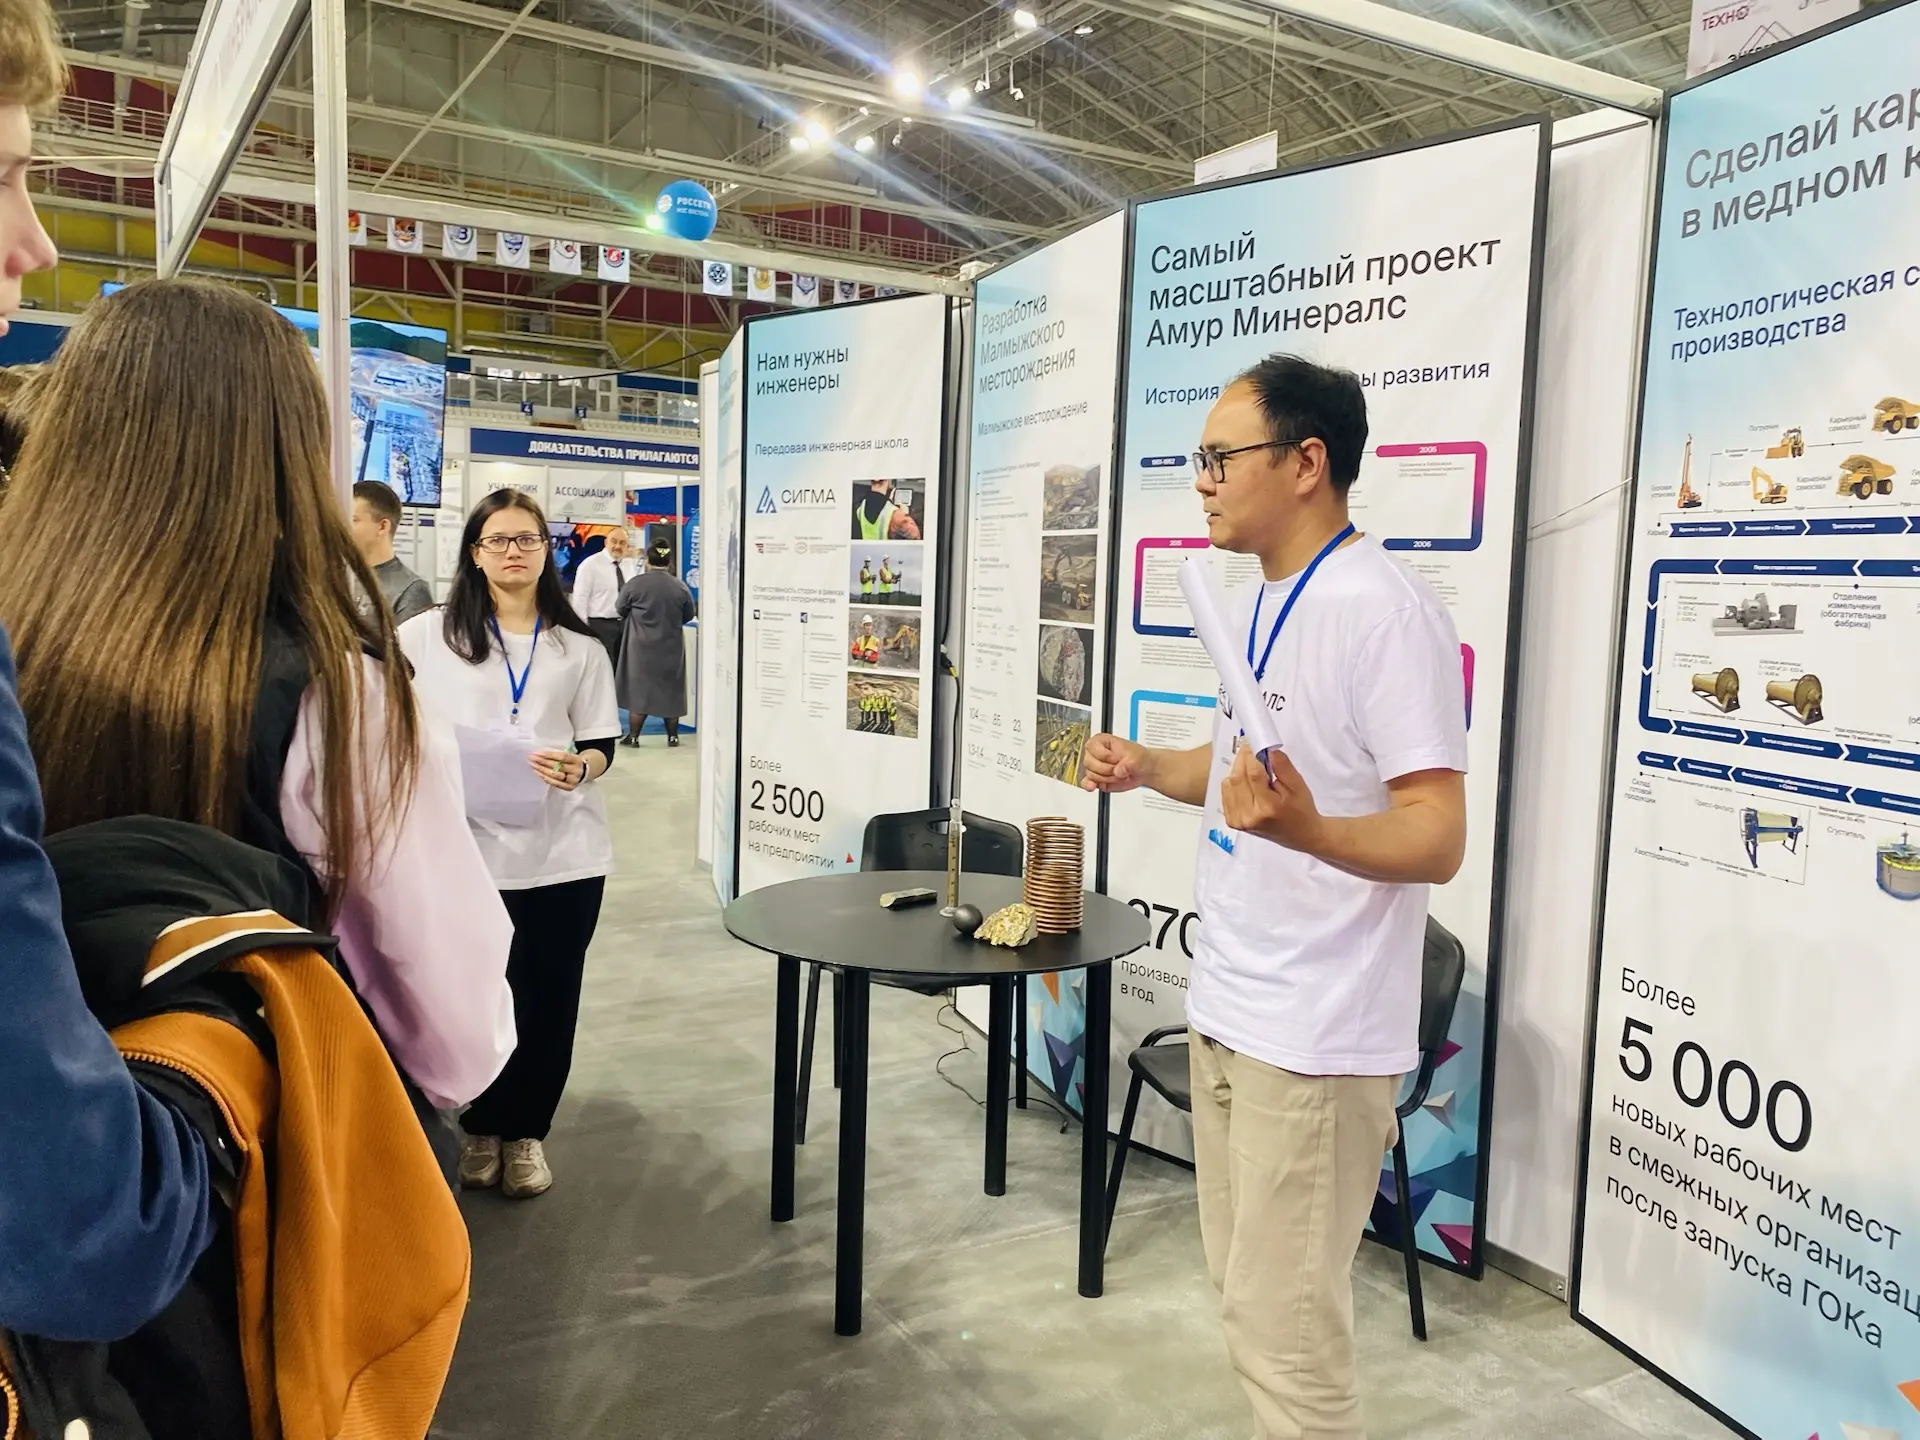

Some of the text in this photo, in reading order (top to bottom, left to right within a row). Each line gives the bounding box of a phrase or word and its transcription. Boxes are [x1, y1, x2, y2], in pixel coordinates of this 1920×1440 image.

[1686, 104, 1839, 190] Сделай
[1681, 208, 1701, 239] в
[1712, 152, 1888, 231] медном
[1151, 230, 1256, 274] Самый
[1149, 238, 1500, 311] масштабный проект
[982, 294, 1047, 336] Разработка
[1146, 293, 1407, 350] Амур Минералс
[1674, 269, 1894, 331] Технологическая
[980, 319, 1065, 366] Малмыжского
[1671, 312, 1847, 362] производства
[757, 347, 849, 372] Нам нужны
[979, 348, 1076, 394] месторождения
[756, 372, 840, 396] инженеры
[1145, 386, 1219, 405] История
[1383, 362, 1490, 388] развития
[978, 400, 1088, 437] Малмыжское месторождение
[528, 440, 699, 465] ДОКАЗАТЕЛЬСТВА ПРИЛАГАЮТСЯ
[755, 438, 909, 456] Передовая инженерная школа
[555, 486, 615, 499] АССОЦИАЦИЙ
[781, 488, 836, 505] СИГМА
[1832, 592, 1877, 601] Отделение
[750, 755, 782, 773] Более
[750, 780, 824, 822] 2 500
[749, 820, 821, 845] рабочих мест
[748, 840, 834, 869] на предприятии
[1120, 983, 1155, 1004] в год
[1621, 966, 1696, 1017] Более
[1618, 1016, 1812, 1153] 5 000
[1611, 1094, 1902, 1251] новых рабочих мест
[1610, 1135, 1920, 1323] в смежных организац
[1606, 1176, 1883, 1349] после запуска ГОКа
